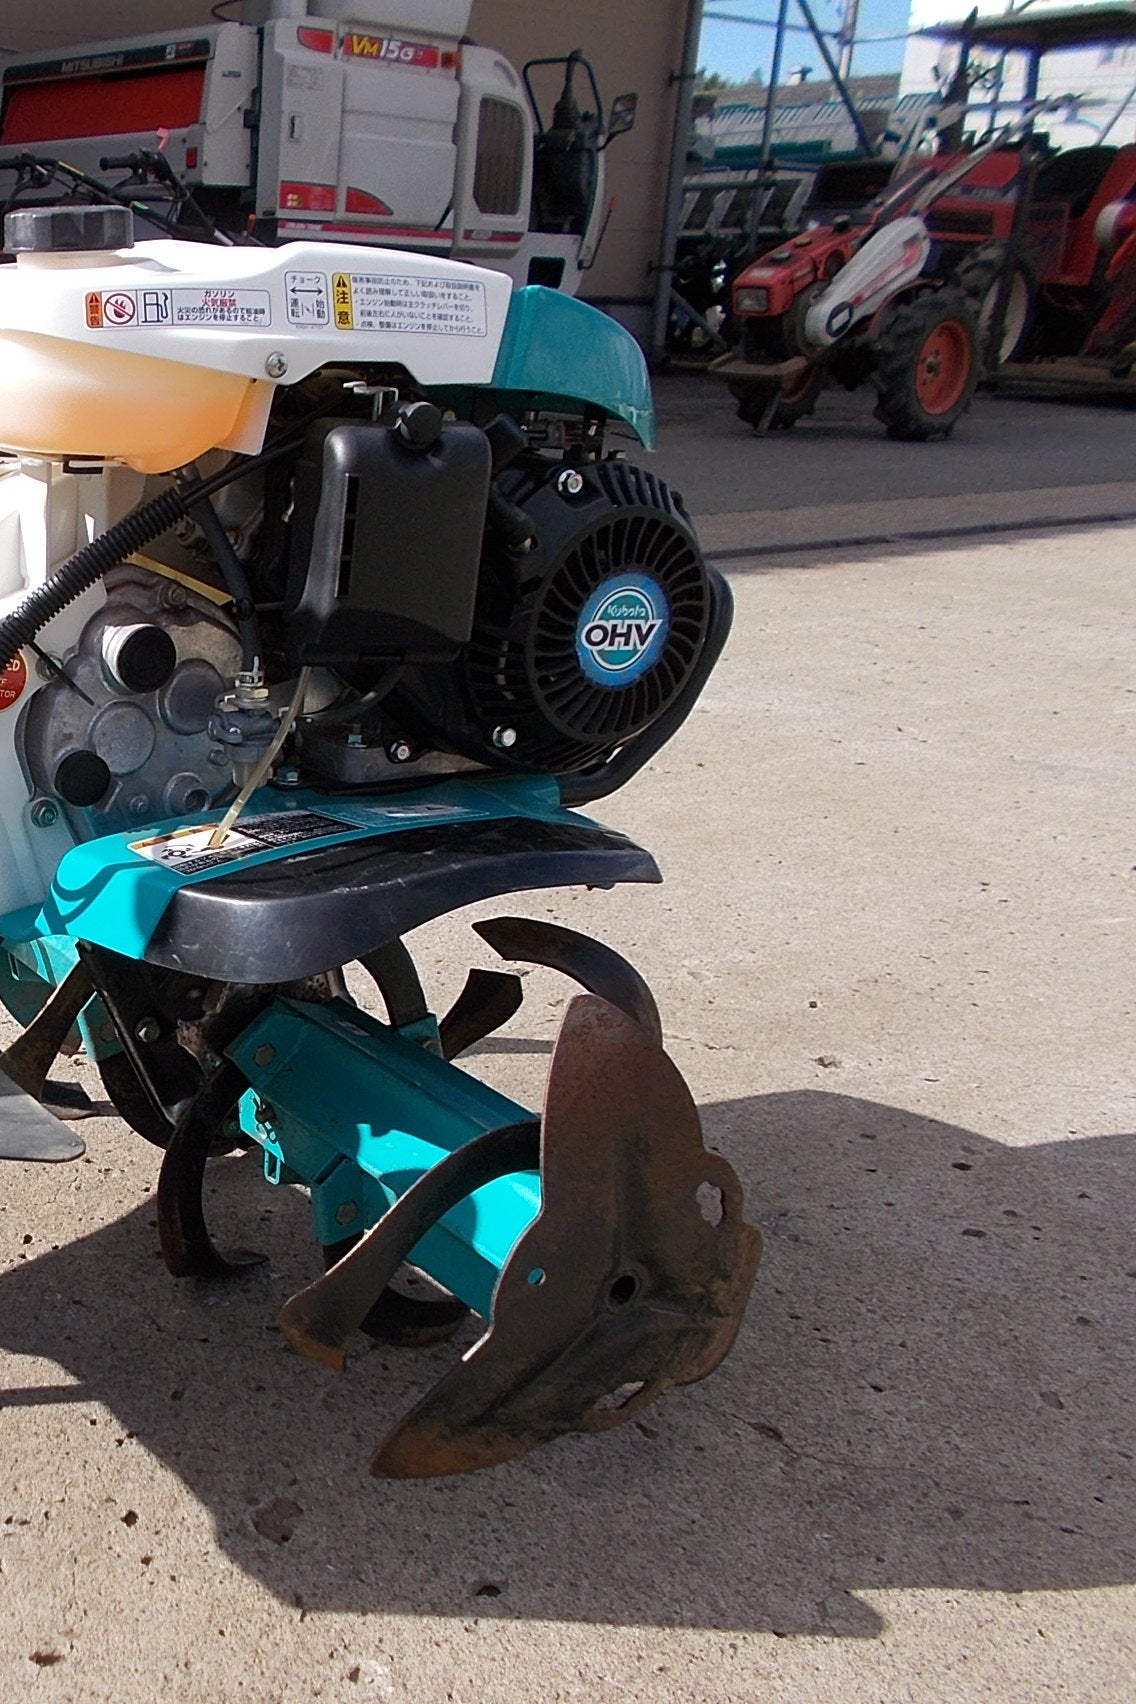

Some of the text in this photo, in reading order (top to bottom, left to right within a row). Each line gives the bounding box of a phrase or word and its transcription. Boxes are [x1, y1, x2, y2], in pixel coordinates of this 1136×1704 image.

[290, 275, 321, 284] チョーク
[204, 290, 235, 298] ガソリン
[201, 298, 236, 307] 火気厳禁
[336, 290, 350, 325] 注意
[607, 604, 646, 617] Kubota
[583, 622, 659, 648] OHV
